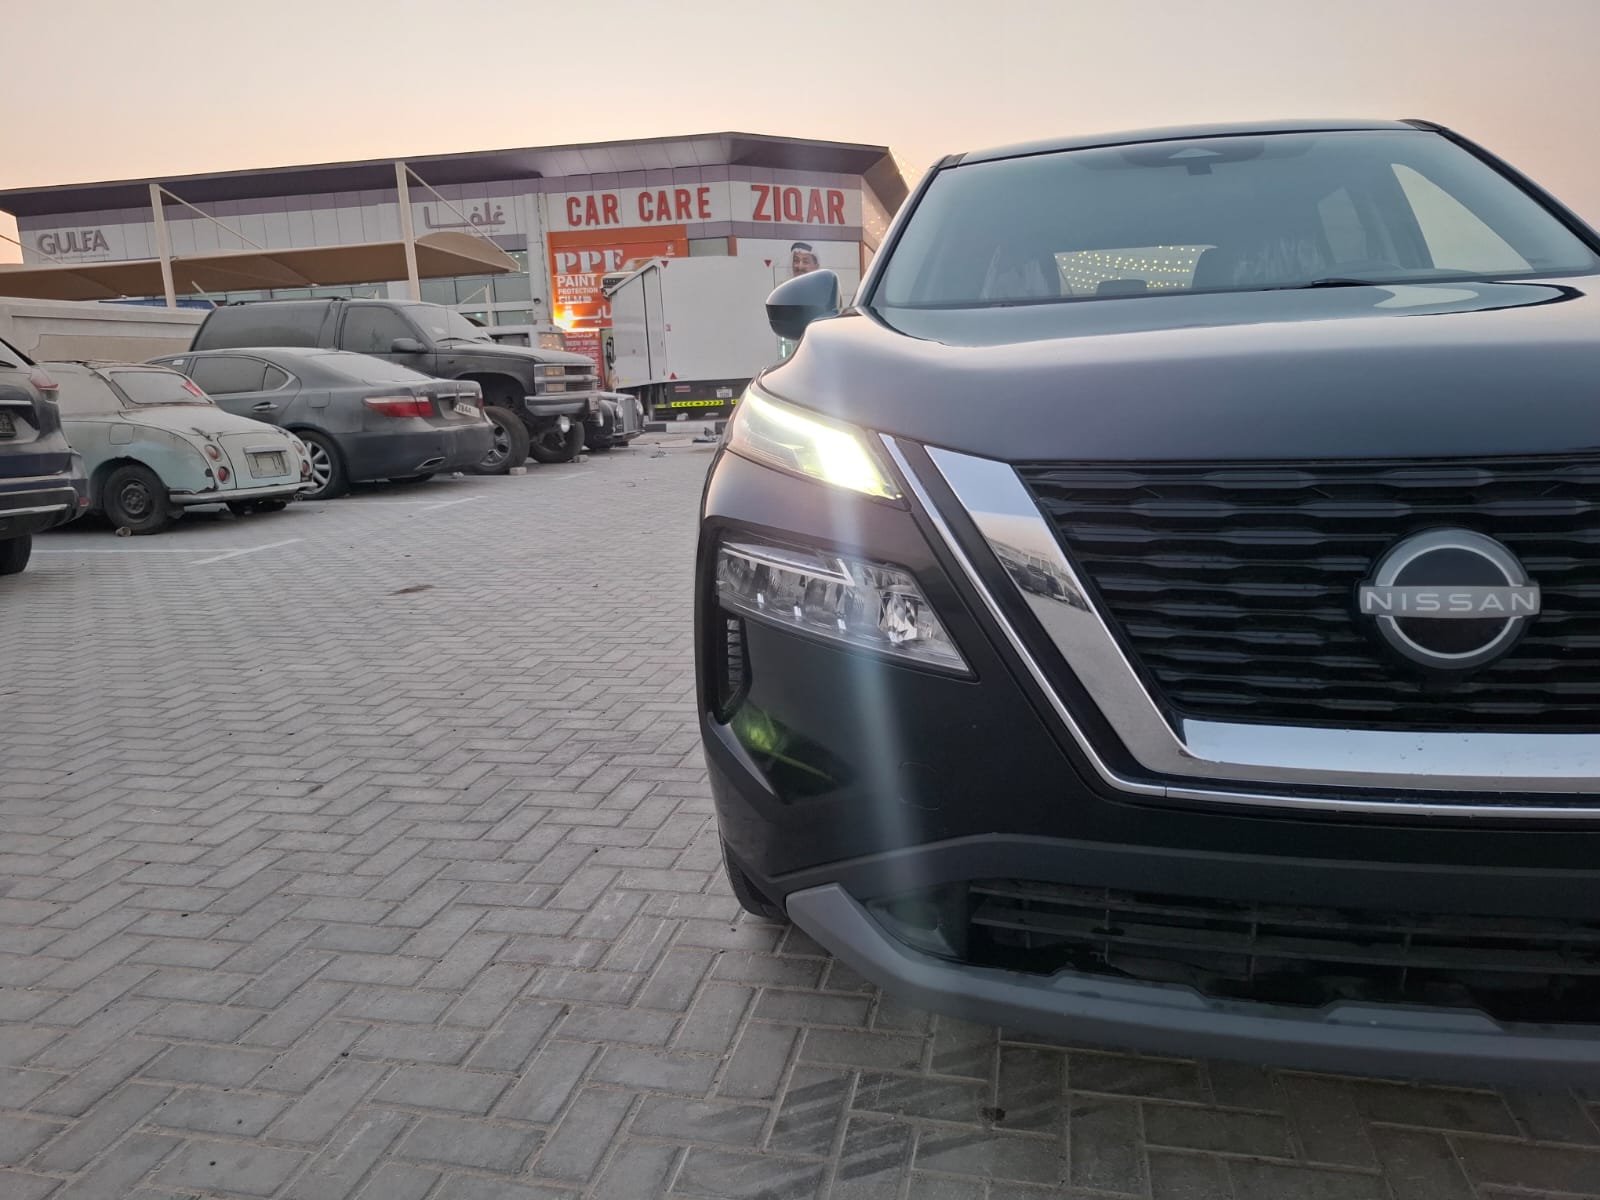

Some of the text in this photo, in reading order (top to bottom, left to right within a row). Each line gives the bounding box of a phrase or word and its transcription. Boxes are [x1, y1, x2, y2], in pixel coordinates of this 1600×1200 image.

[423, 202, 506, 229] غلفا
[566, 187, 712, 227] CAR CARE
[750, 184, 846, 225] ZIQAR
[38, 229, 110, 255] GULFA
[553, 249, 623, 275] PPF
[557, 275, 597, 287] PAINT
[558, 287, 598, 295] PROTECTION
[1365, 591, 1535, 611] NISSAN
